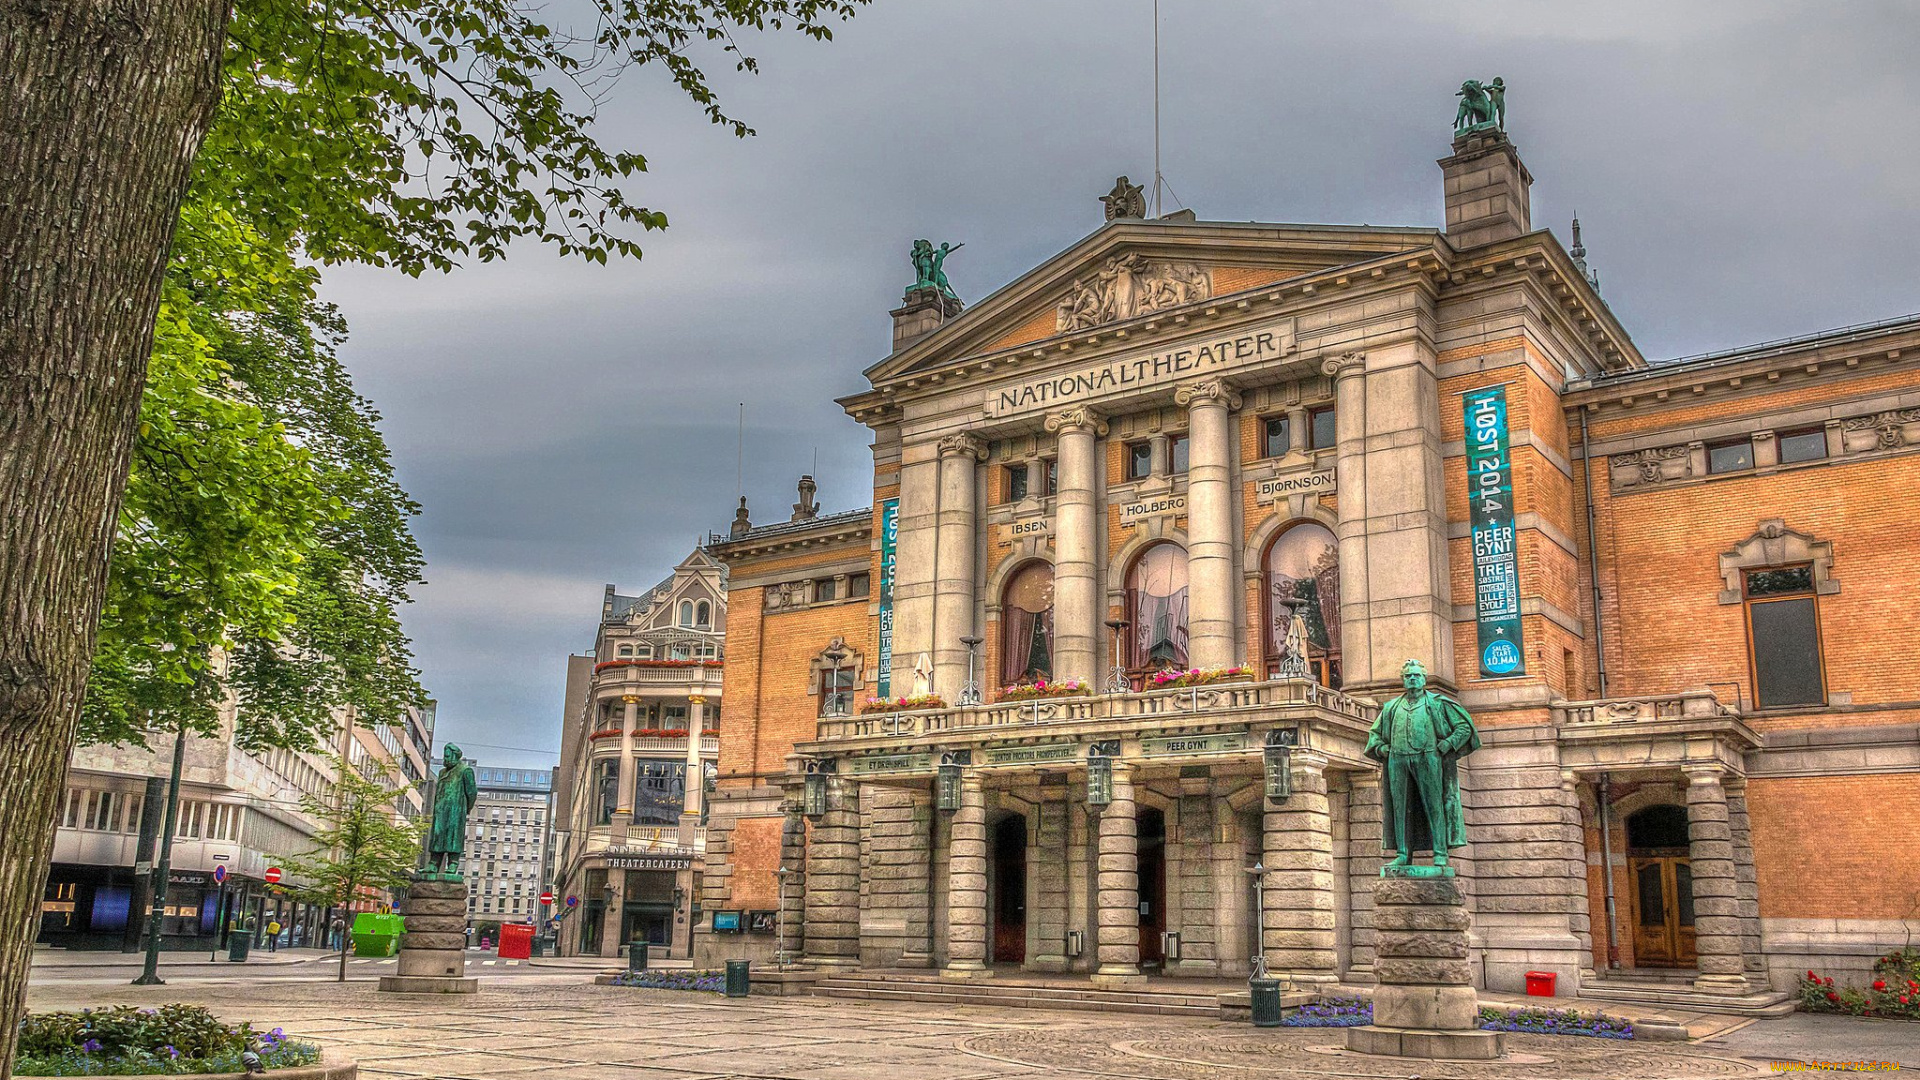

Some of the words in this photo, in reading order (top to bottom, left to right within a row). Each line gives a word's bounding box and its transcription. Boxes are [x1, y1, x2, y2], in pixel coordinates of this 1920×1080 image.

[1000, 332, 1275, 410] NATIONALTHEATER
[1475, 397, 1498, 451] HØST
[1262, 475, 1332, 495] BJØRNSON
[1479, 457, 1502, 513] 2014
[1126, 498, 1185, 516] HOLBERG
[1011, 520, 1048, 535] IBSEN
[1475, 526, 1512, 544] PEER
[1475, 539, 1512, 556] GYNT
[1478, 563, 1504, 577] TRE
[1478, 575, 1504, 585] SØSTRE
[1480, 583, 1504, 593] UNGEN
[1479, 592, 1505, 602] LILLE
[1480, 600, 1505, 611] EYOLF
[881, 609, 893, 621] PE
[881, 619, 893, 631] GY
[1487, 655, 1517, 666] 10.MAI
[1166, 741, 1185, 751] PEER
[1188, 740, 1208, 750] GYNT
[868, 761, 876, 770] ET
[607, 858, 690, 869] THEATERCAFEEN
